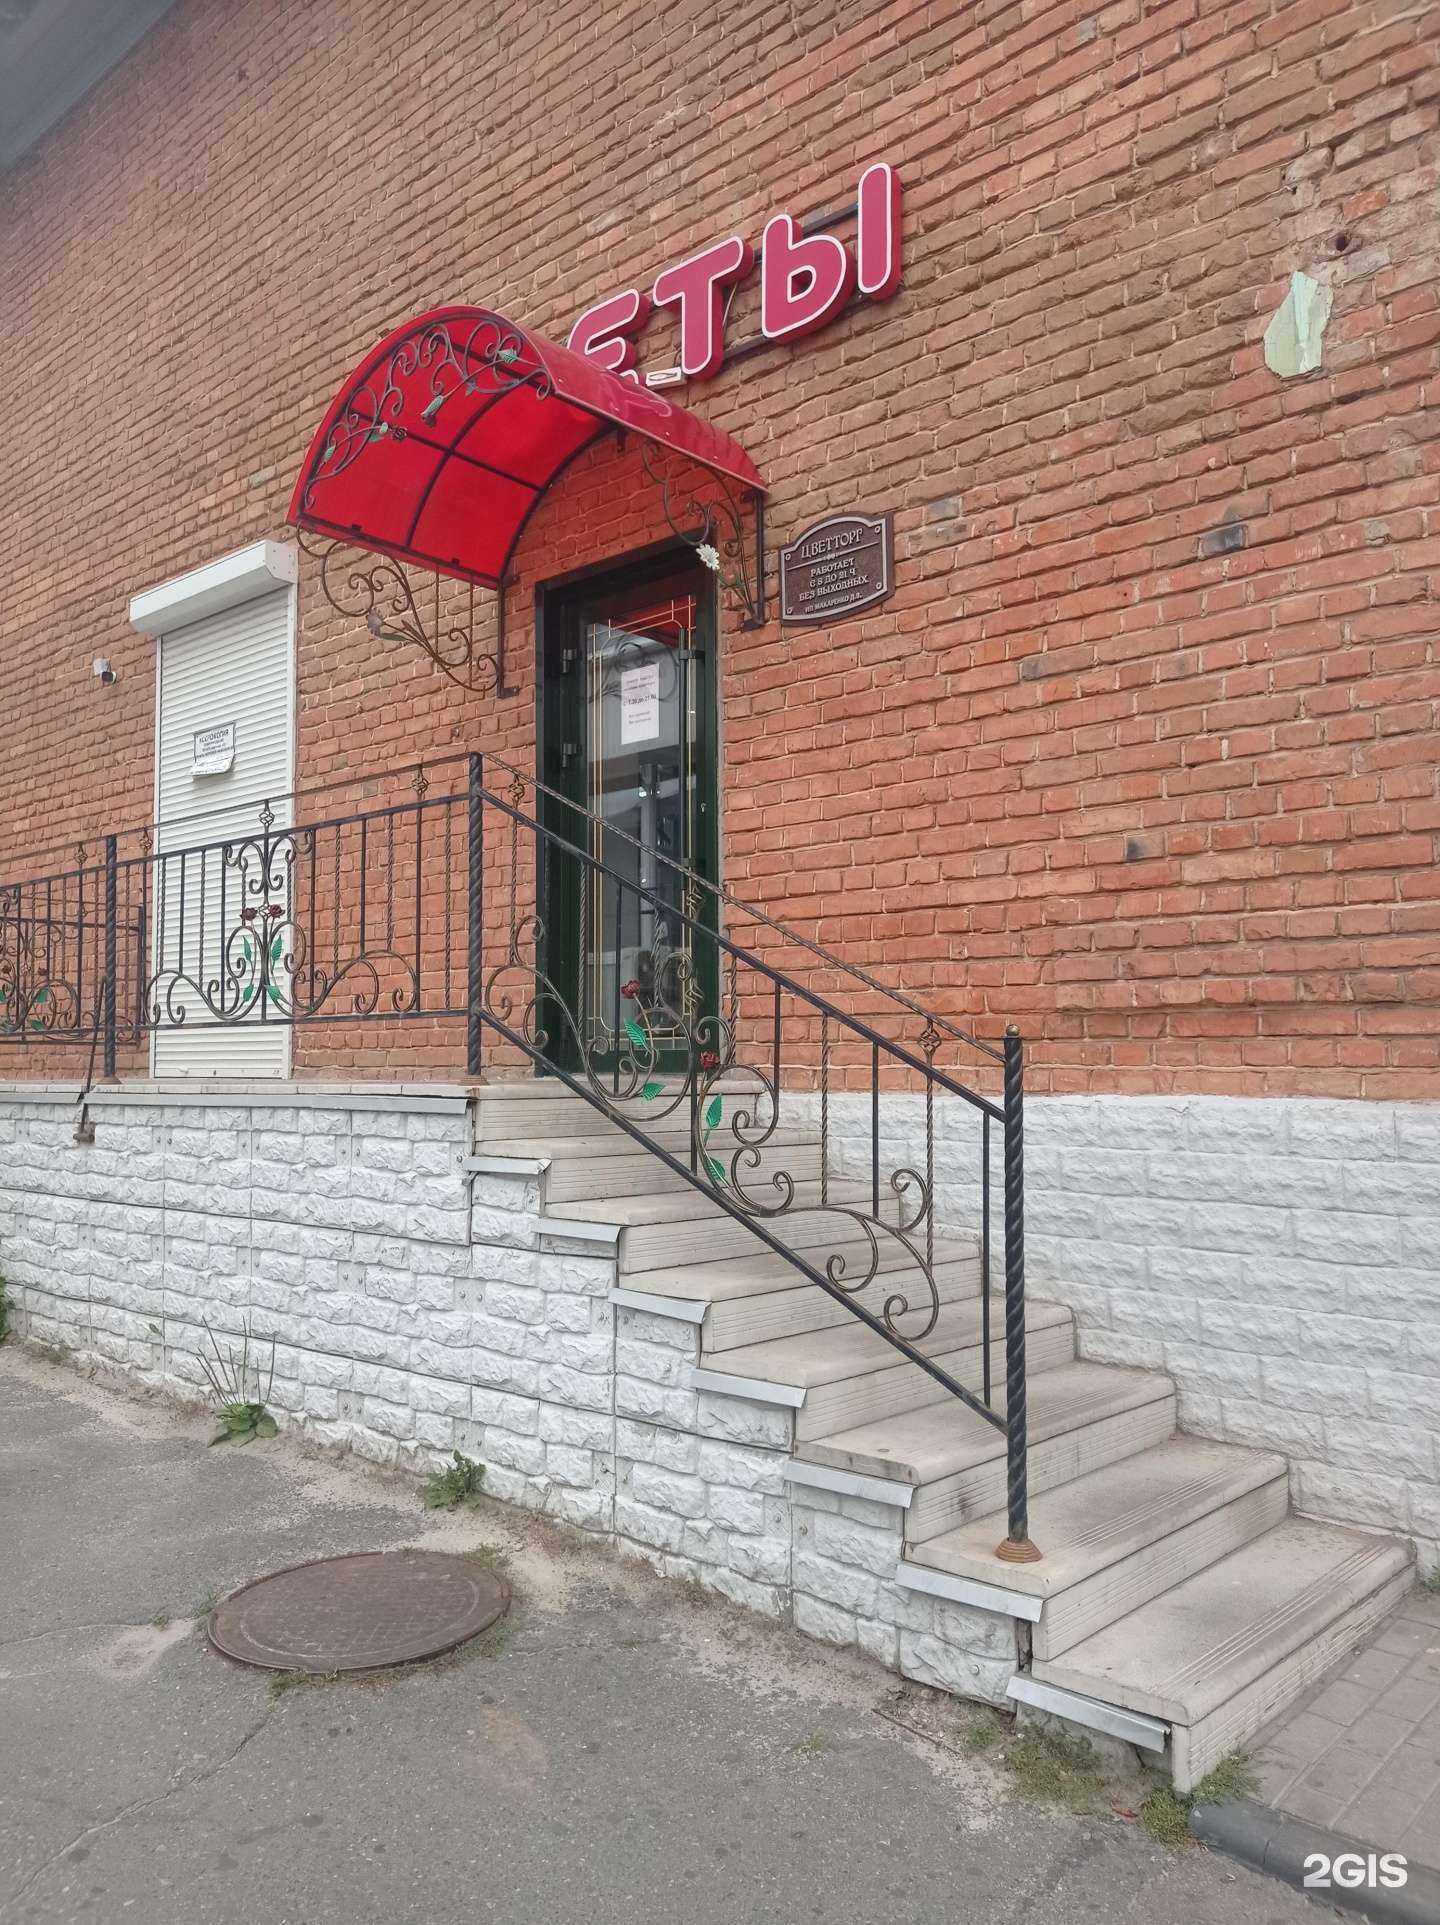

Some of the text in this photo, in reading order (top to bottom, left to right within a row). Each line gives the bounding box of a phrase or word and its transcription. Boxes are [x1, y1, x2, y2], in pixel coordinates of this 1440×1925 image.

[801, 528, 863, 558] ЦВЕТТОРГ
[809, 579, 816, 588] С
[824, 573, 837, 584] ДО
[849, 567, 856, 576] Ч
[810, 558, 855, 577] РАБОТАЕТ
[799, 575, 870, 602] БЕЗ ВЫХОДНЫХ
